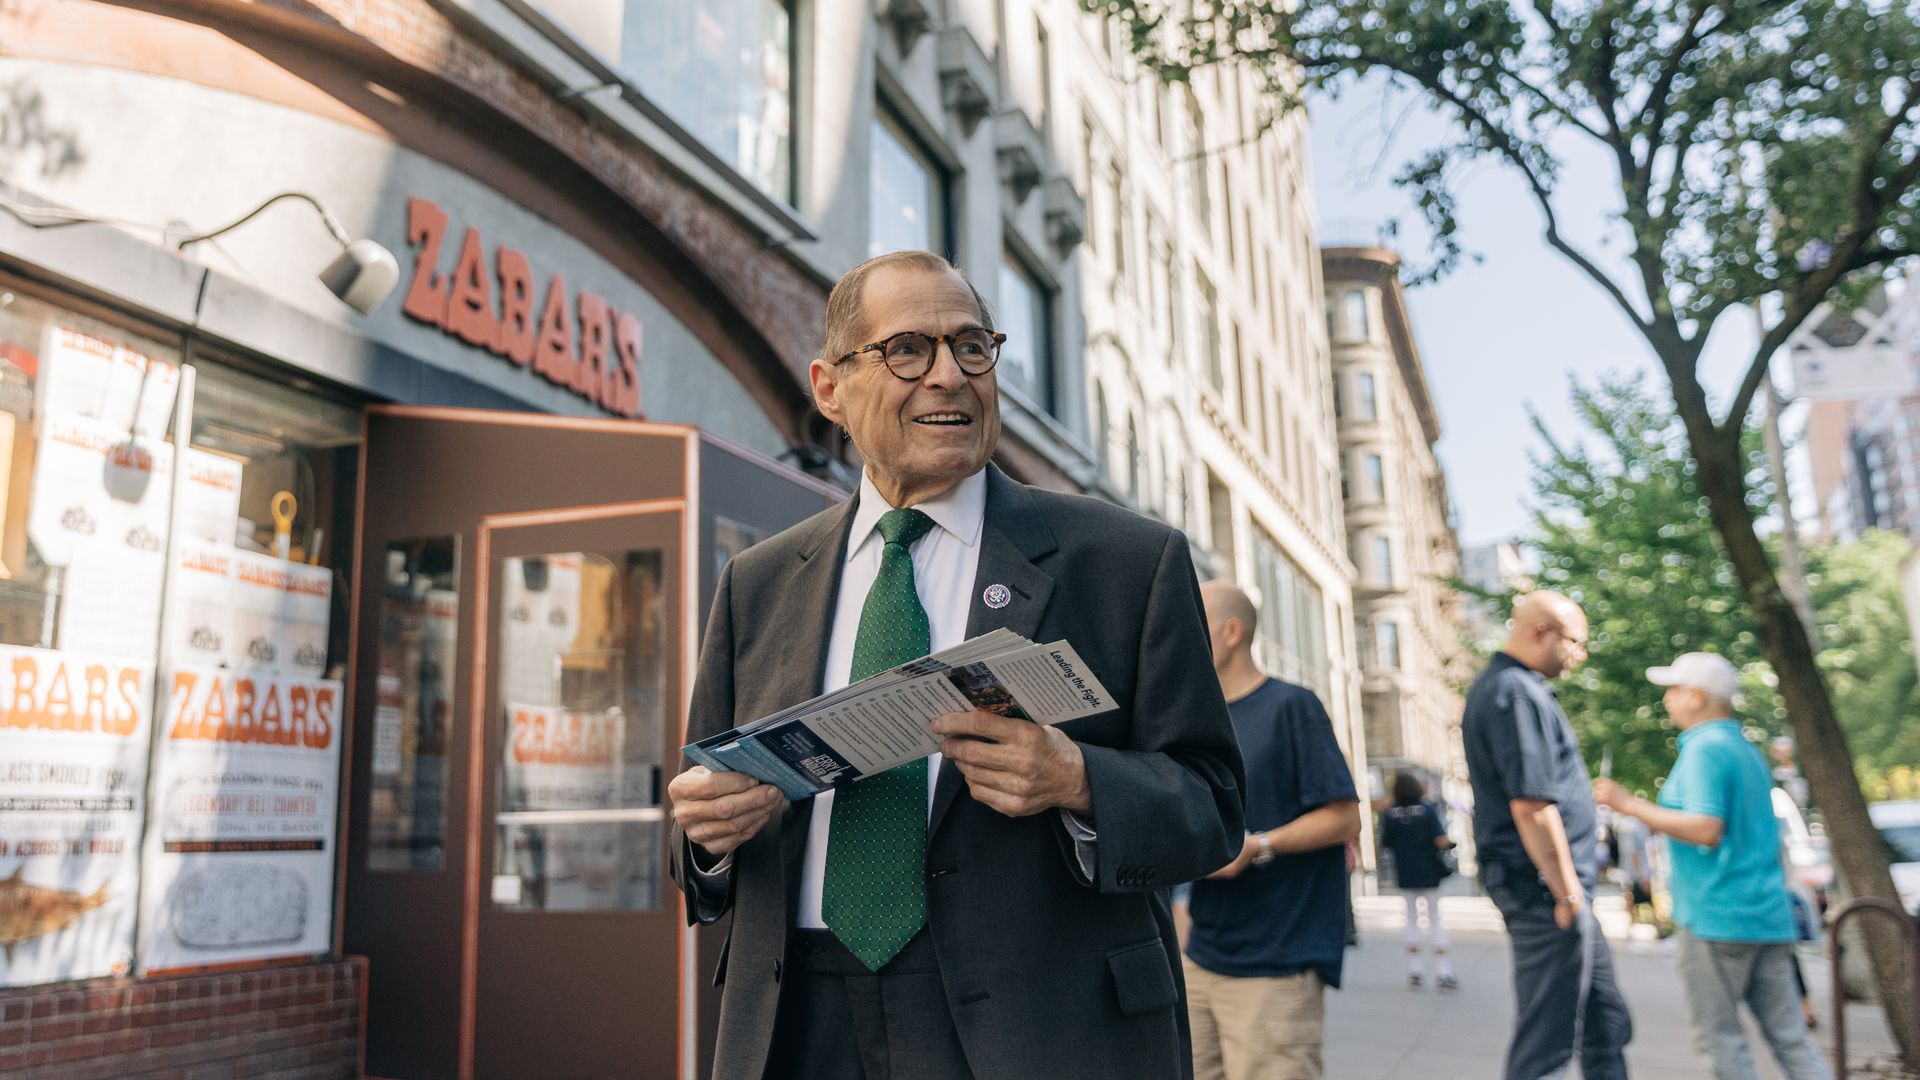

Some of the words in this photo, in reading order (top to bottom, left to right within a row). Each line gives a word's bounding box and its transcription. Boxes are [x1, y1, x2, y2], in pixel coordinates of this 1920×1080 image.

[1050, 650, 1076, 678] Leading
[1072, 677, 1085, 689] the
[1081, 688, 1100, 708] Fight.
[811, 754, 841, 772] JERRY
